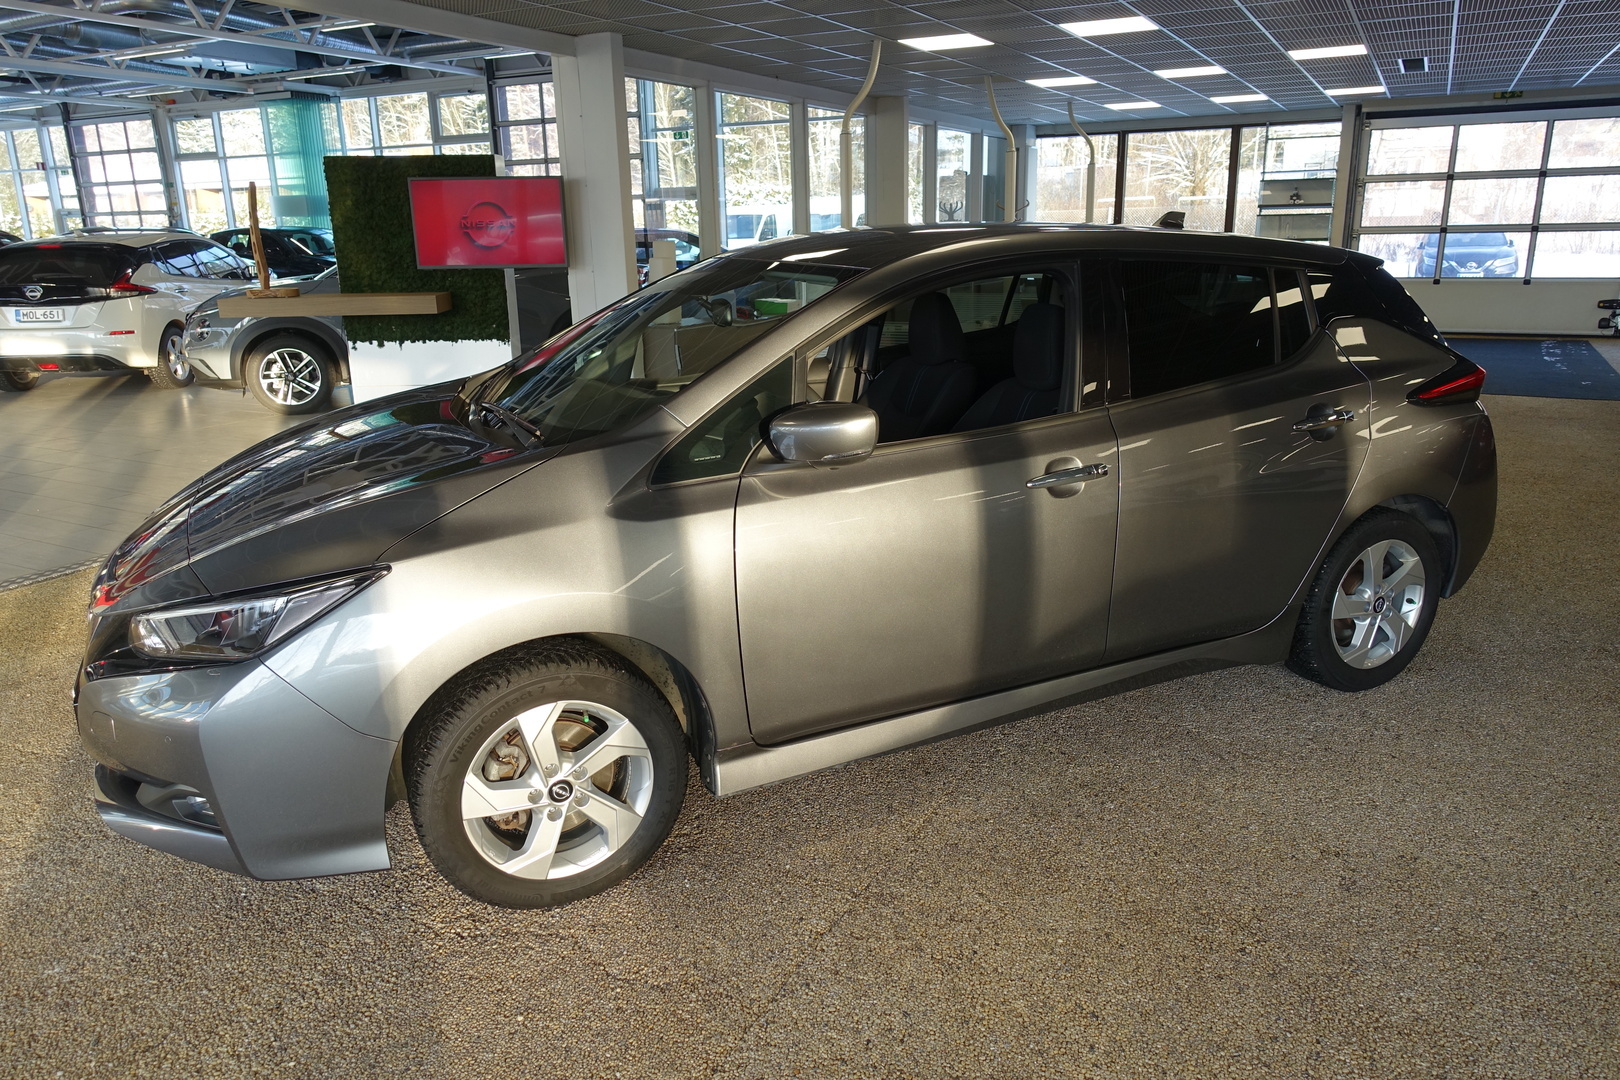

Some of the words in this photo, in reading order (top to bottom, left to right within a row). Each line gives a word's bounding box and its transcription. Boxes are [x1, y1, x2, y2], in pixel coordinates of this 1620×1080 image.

[460, 220, 515, 230] NISSAN
[449, 687, 532, 763] VikingContact
[537, 684, 546, 694] 7
